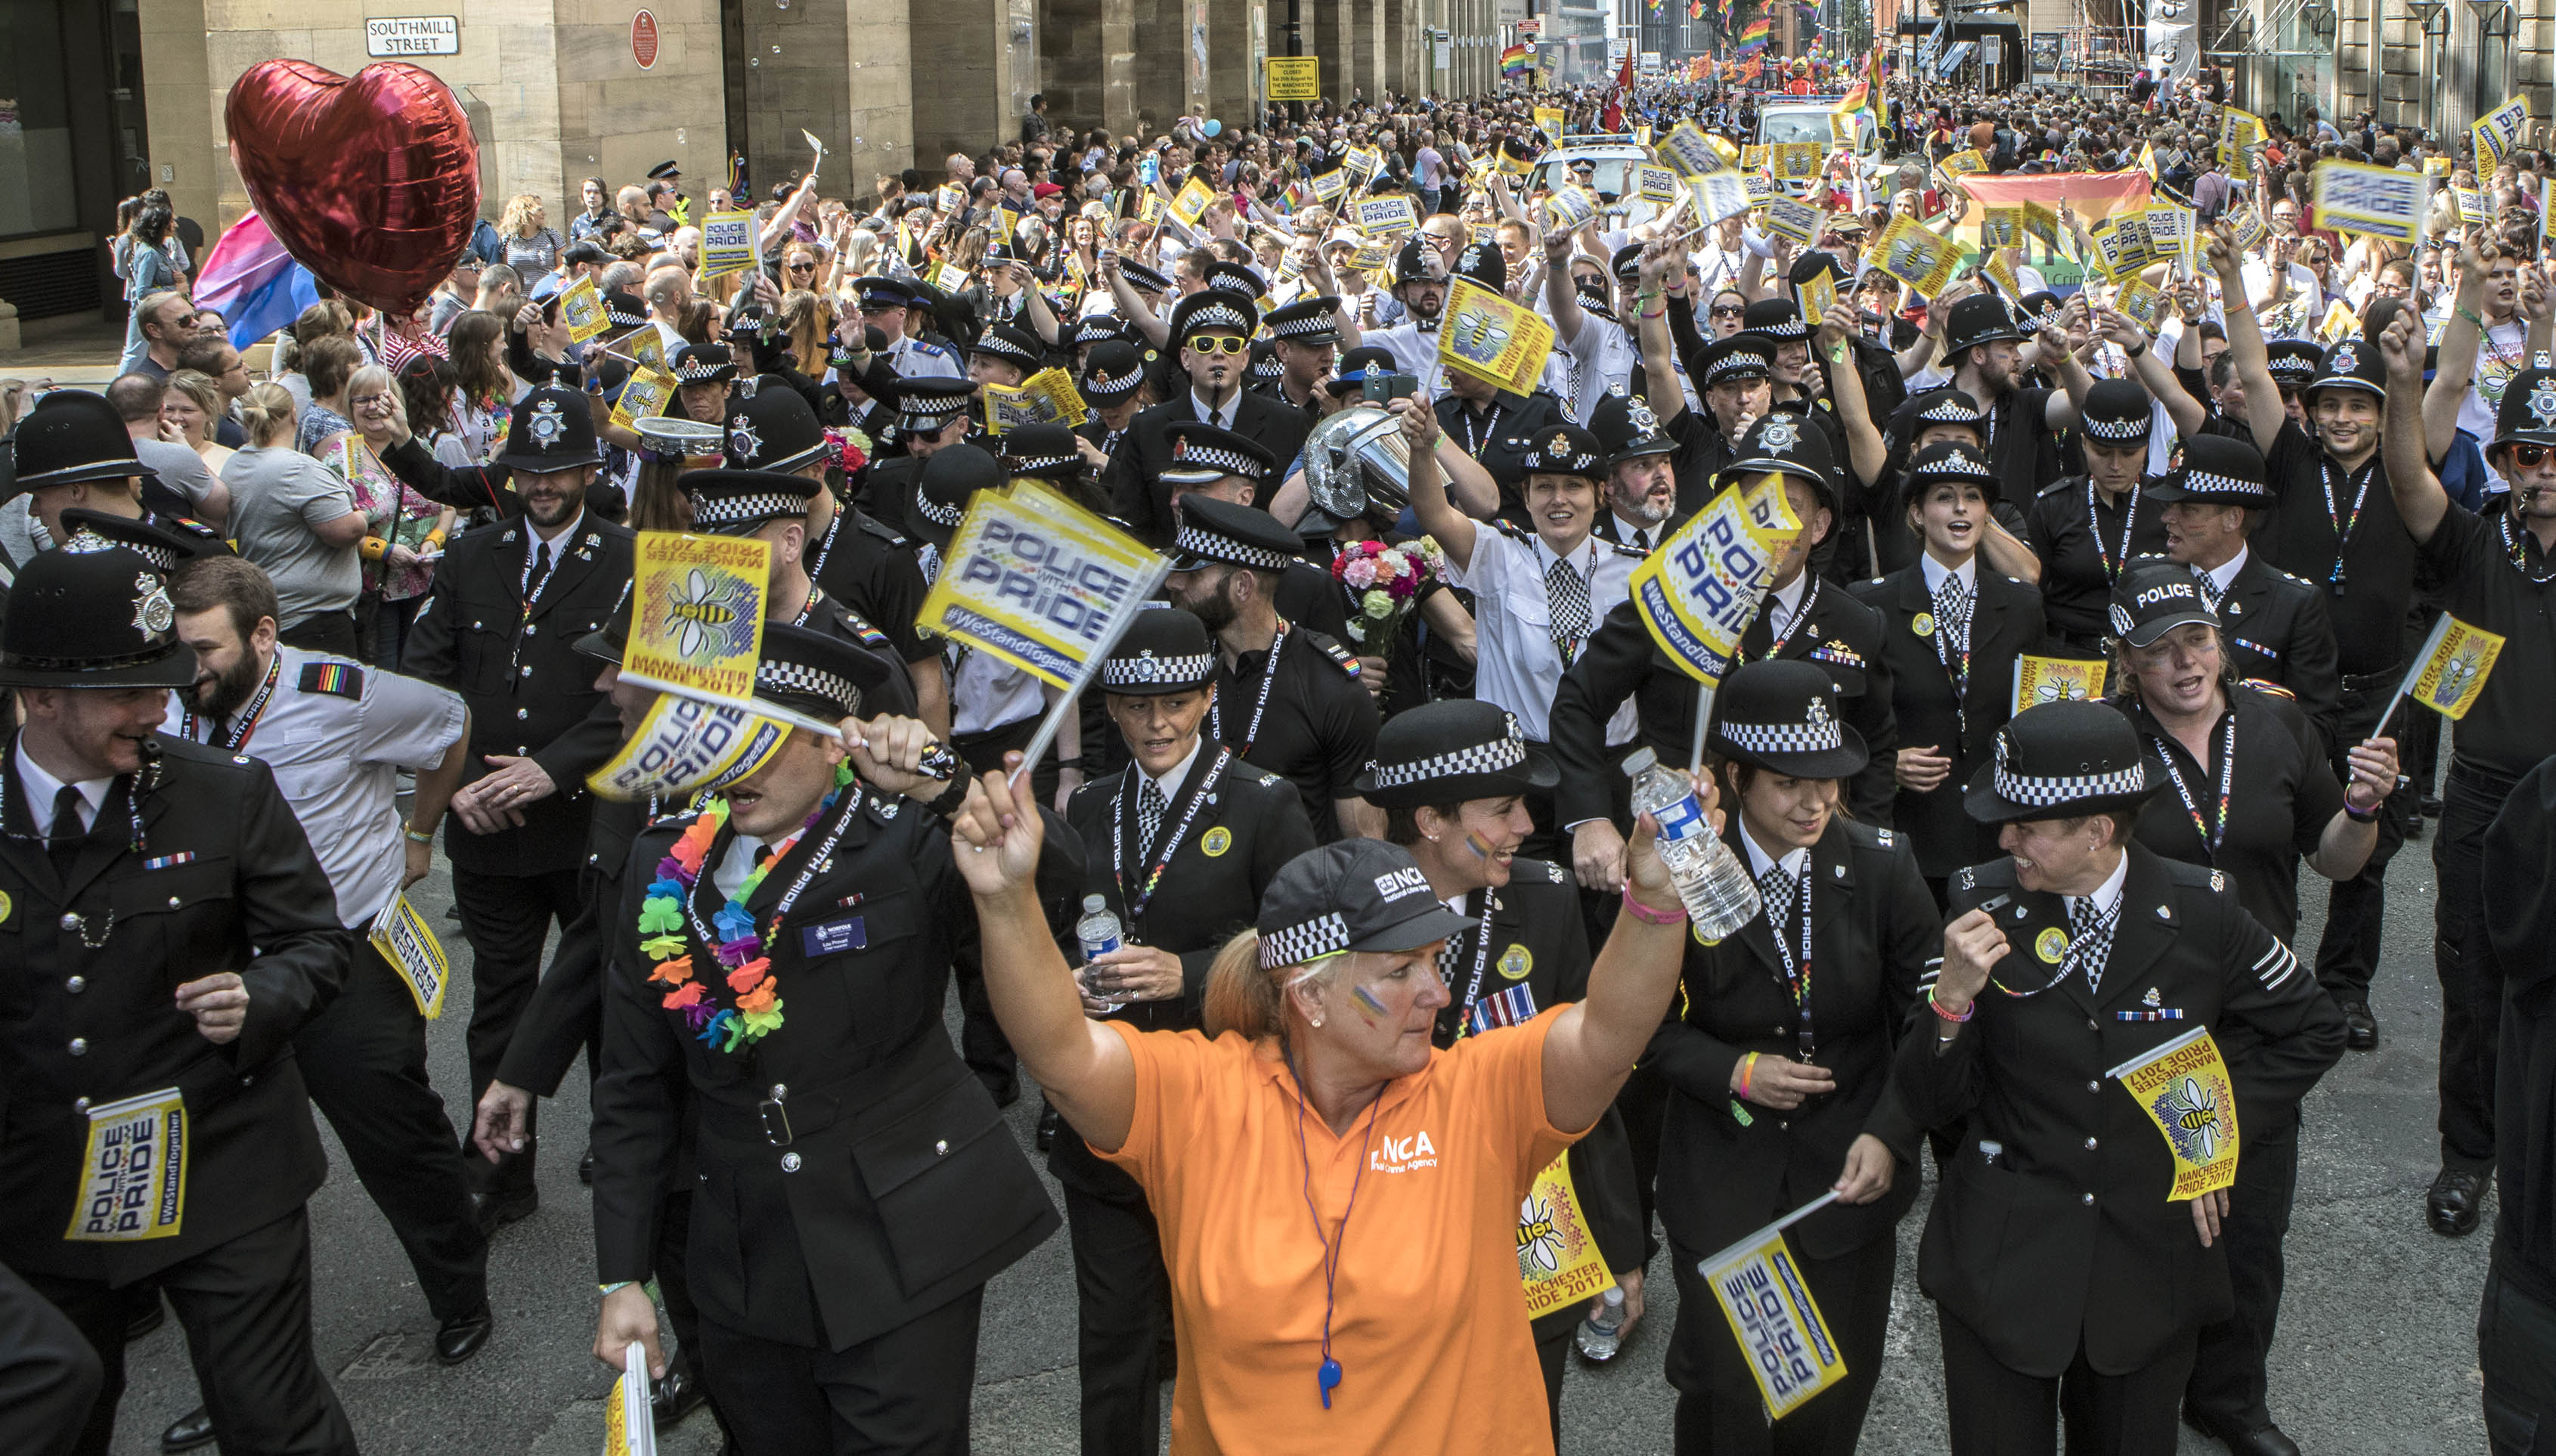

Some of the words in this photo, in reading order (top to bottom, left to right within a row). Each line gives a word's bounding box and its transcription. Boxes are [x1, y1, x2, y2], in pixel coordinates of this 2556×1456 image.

[369, 21, 454, 36] SOUTHMILL
[386, 38, 438, 51] STREET
[1643, 169, 1672, 180] POLICE
[1643, 180, 1673, 191] PRIDE
[1362, 200, 1405, 212] POLICE
[1364, 209, 1408, 223] PRIDE
[2148, 212, 2174, 222] POLICE
[706, 234, 748, 246] PRIDE
[707, 223, 745, 234] POLICE
[2152, 226, 2177, 237] PRIDE
[572, 319, 608, 337] MANCHESTER
[573, 330, 593, 342] PRIDE
[593, 323, 609, 334] 2017
[613, 415, 634, 429] PRIDE
[2325, 485, 2335, 514] POLICE
[2354, 485, 2367, 510] PRIDE
[646, 537, 696, 552] 2017
[824, 516, 841, 550] POLICE
[2120, 530, 2131, 559] POLICE
[646, 550, 765, 569] MANCHESTER
[706, 540, 766, 558] PRIDE
[813, 552, 828, 575] WITH
[980, 518, 1132, 603] POLICE
[1708, 514, 1766, 592] POL
[929, 550, 938, 583] POLICE
[1036, 568, 1072, 593] WITH
[960, 553, 1111, 643] PRIDE
[1344, 584, 1361, 610] PRIDE
[1801, 592, 1817, 616] WITH
[1966, 599, 1977, 621] WITH
[2136, 583, 2194, 609] POLICE
[1644, 579, 1727, 675] #WeStandToget
[1782, 614, 1803, 641] PRIDE
[1932, 602, 1941, 627] WITH
[1266, 634, 1284, 674] POLICE
[1935, 630, 1947, 665] POLICE
[2435, 626, 2463, 662] PRIDE
[631, 654, 748, 683] MANCHESTER
[2021, 660, 2031, 692] PRIDE
[2418, 664, 2435, 696] 2017
[697, 679, 748, 696] 2017
[1258, 677, 1272, 705] WITH
[2027, 661, 2037, 707] MANCHES
[226, 720, 249, 749] WITH
[246, 685, 271, 720] PRIDE
[1247, 708, 1263, 742] PRIDE
[612, 698, 703, 788] POLIC
[2154, 738, 2173, 766] WITH
[2225, 723, 2235, 754] WITH
[1204, 750, 1230, 790] POLICE
[2221, 757, 2232, 795] PRIDE
[696, 788, 714, 810] ICE
[2169, 767, 2195, 810] POLICE
[835, 787, 863, 835] POLICE
[1180, 788, 1207, 825] WITH
[807, 835, 838, 872] WITH
[1114, 830, 1123, 871] POLICE
[1162, 824, 1188, 863] PRIDE
[1802, 848, 1812, 874] ICE
[781, 871, 816, 912] PRIDE
[1393, 866, 1427, 888] NCA
[1383, 888, 1407, 903] National
[1802, 877, 1812, 913] WITH
[2095, 890, 2124, 930] PRIDE
[828, 924, 851, 932] NORFOLK
[1479, 908, 1495, 947] WITH
[1802, 916, 1812, 960] PRIDE
[2064, 928, 2096, 954] WITH
[391, 929, 431, 1004] POLICE
[395, 915, 437, 992] PRIDE
[1772, 928, 1797, 979] POLICE
[1465, 949, 1487, 1006] POLICE
[2168, 1040, 2212, 1066] PRIDE
[2130, 1064, 2165, 1086] 2017
[2133, 1052, 2218, 1094] MANCHESTER
[1383, 1130, 1436, 1163] NCA
[117, 1117, 153, 1232] PRIDE
[162, 1114, 180, 1223] #WeStandTogether
[1407, 1157, 1438, 1171] Agency
[2177, 1157, 2234, 1184] MANCHESTER
[86, 1126, 123, 1233] POLICE
[116, 1169, 127, 1194] WITH
[2173, 1179, 2207, 1195] PRIDE
[2207, 1169, 2232, 1186] 2017
[1523, 1261, 1601, 1299] ANCHESTER
[1567, 1272, 1606, 1300] 2017
[1526, 1290, 1563, 1312] RIDE
[1726, 1275, 1792, 1398] POLICE
[1746, 1263, 1814, 1384] PRIDE
